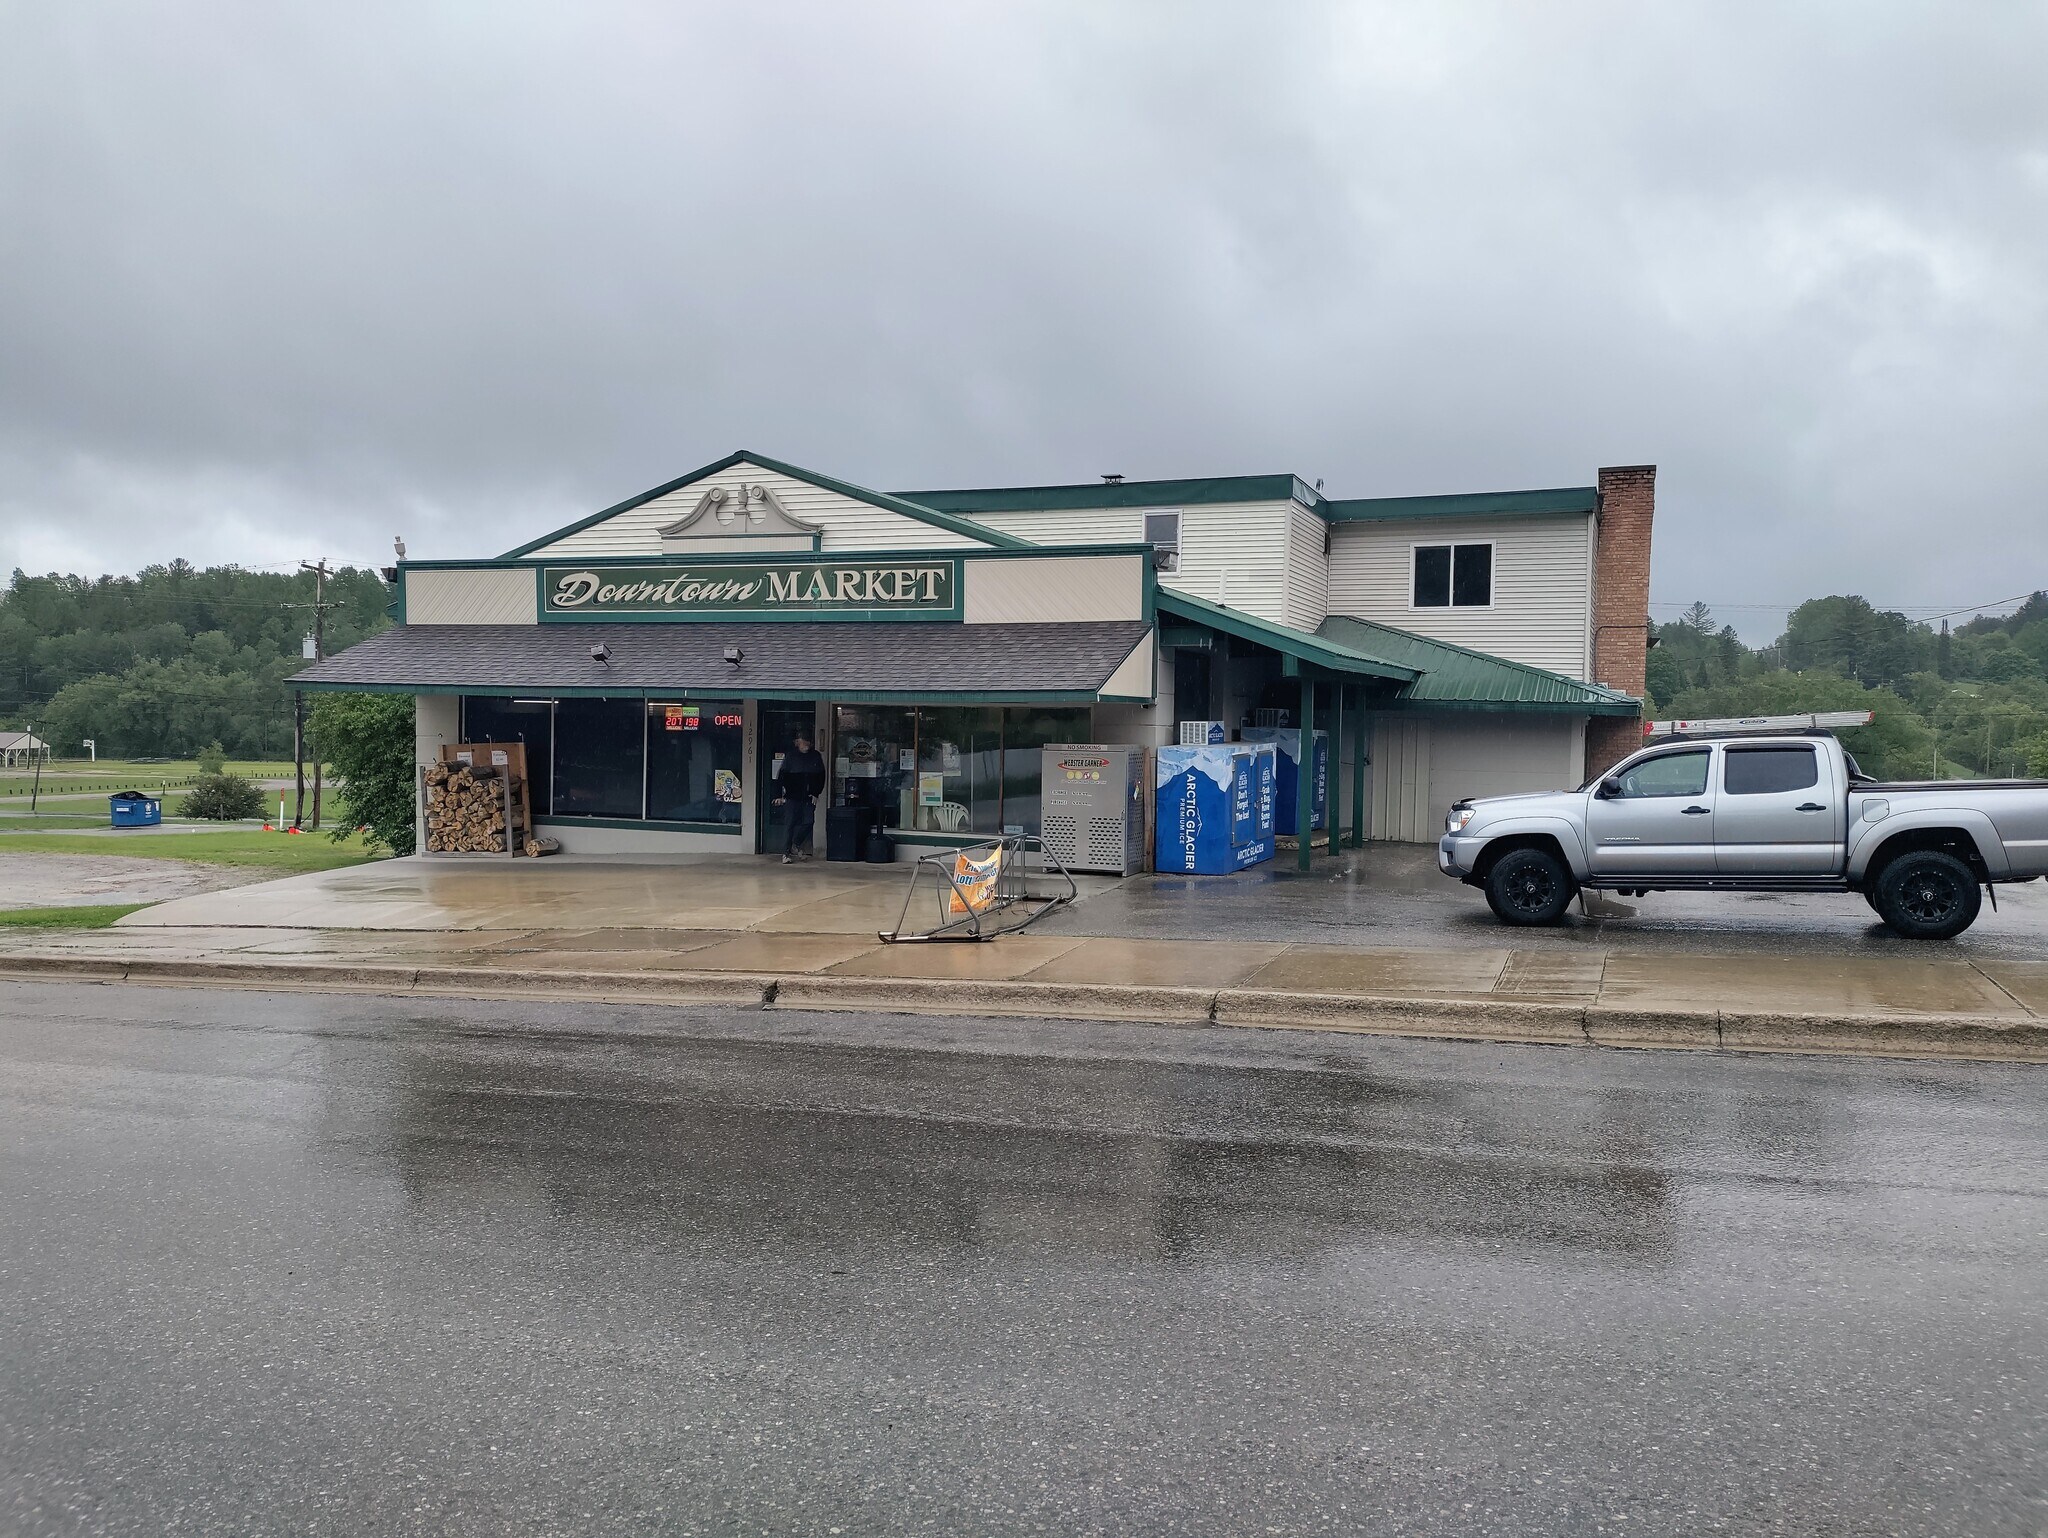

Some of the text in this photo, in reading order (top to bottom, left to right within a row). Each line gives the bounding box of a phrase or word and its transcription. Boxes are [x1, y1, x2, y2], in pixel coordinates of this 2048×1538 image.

[552, 568, 946, 608] Downtown MARKET
[666, 717, 699, 727] 207 198
[714, 715, 742, 726] OPEN
[1063, 759, 1103, 768] WEBSTER GARNER
[1185, 774, 1196, 870] ARCTIC GLACIER
[1236, 843, 1264, 861] ARCTIC GLACIER
